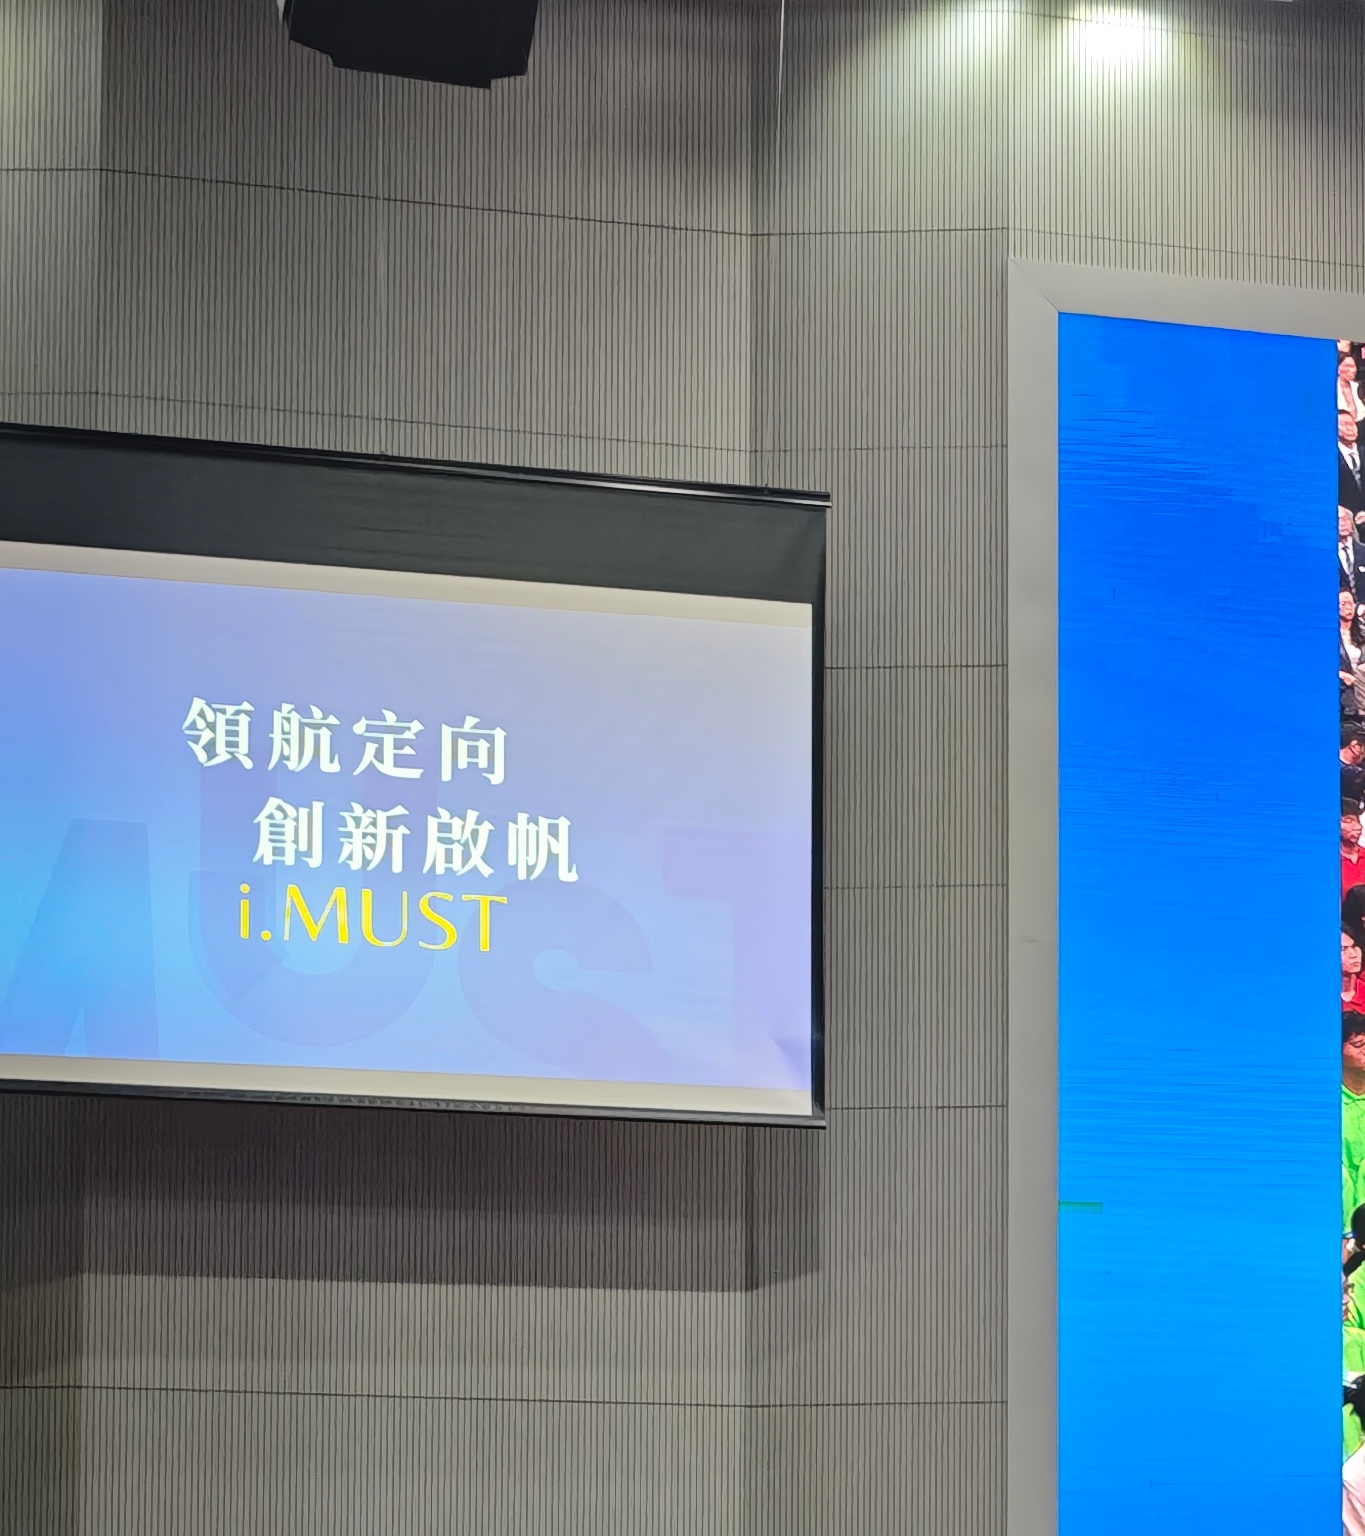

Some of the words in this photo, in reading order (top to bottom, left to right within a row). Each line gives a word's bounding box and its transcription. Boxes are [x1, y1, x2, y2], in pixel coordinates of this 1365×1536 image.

[182, 697, 508, 786] 領航定向
[252, 797, 579, 883] 創新啟帆
[239, 884, 508, 953] i.MUST
